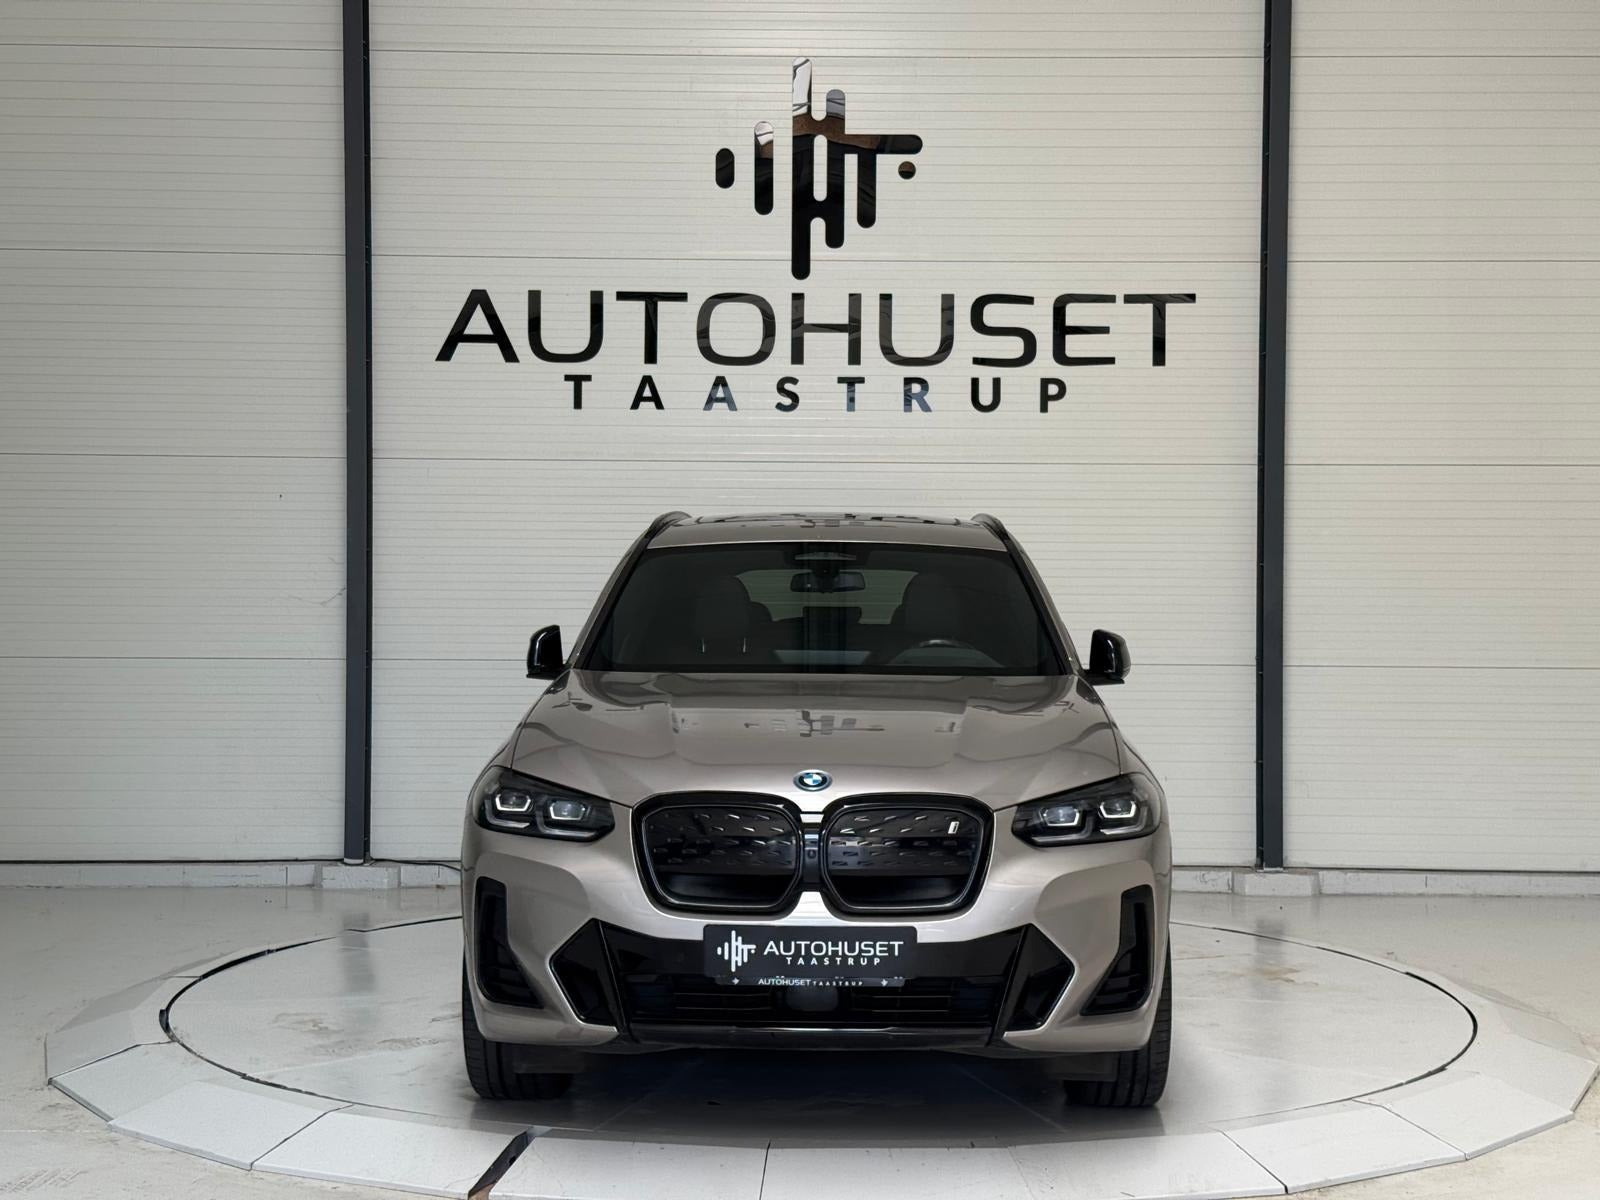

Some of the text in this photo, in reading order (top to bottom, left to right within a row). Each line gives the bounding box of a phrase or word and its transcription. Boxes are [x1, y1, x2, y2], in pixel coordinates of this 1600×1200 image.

[435, 288, 1196, 366] AUTOHUSET
[564, 374, 1067, 413] TAASTRUP
[763, 940, 904, 956] AUTOHUSET
[785, 956, 881, 965] TAASTRUP
[758, 978, 811, 986] AUTOHUSET
